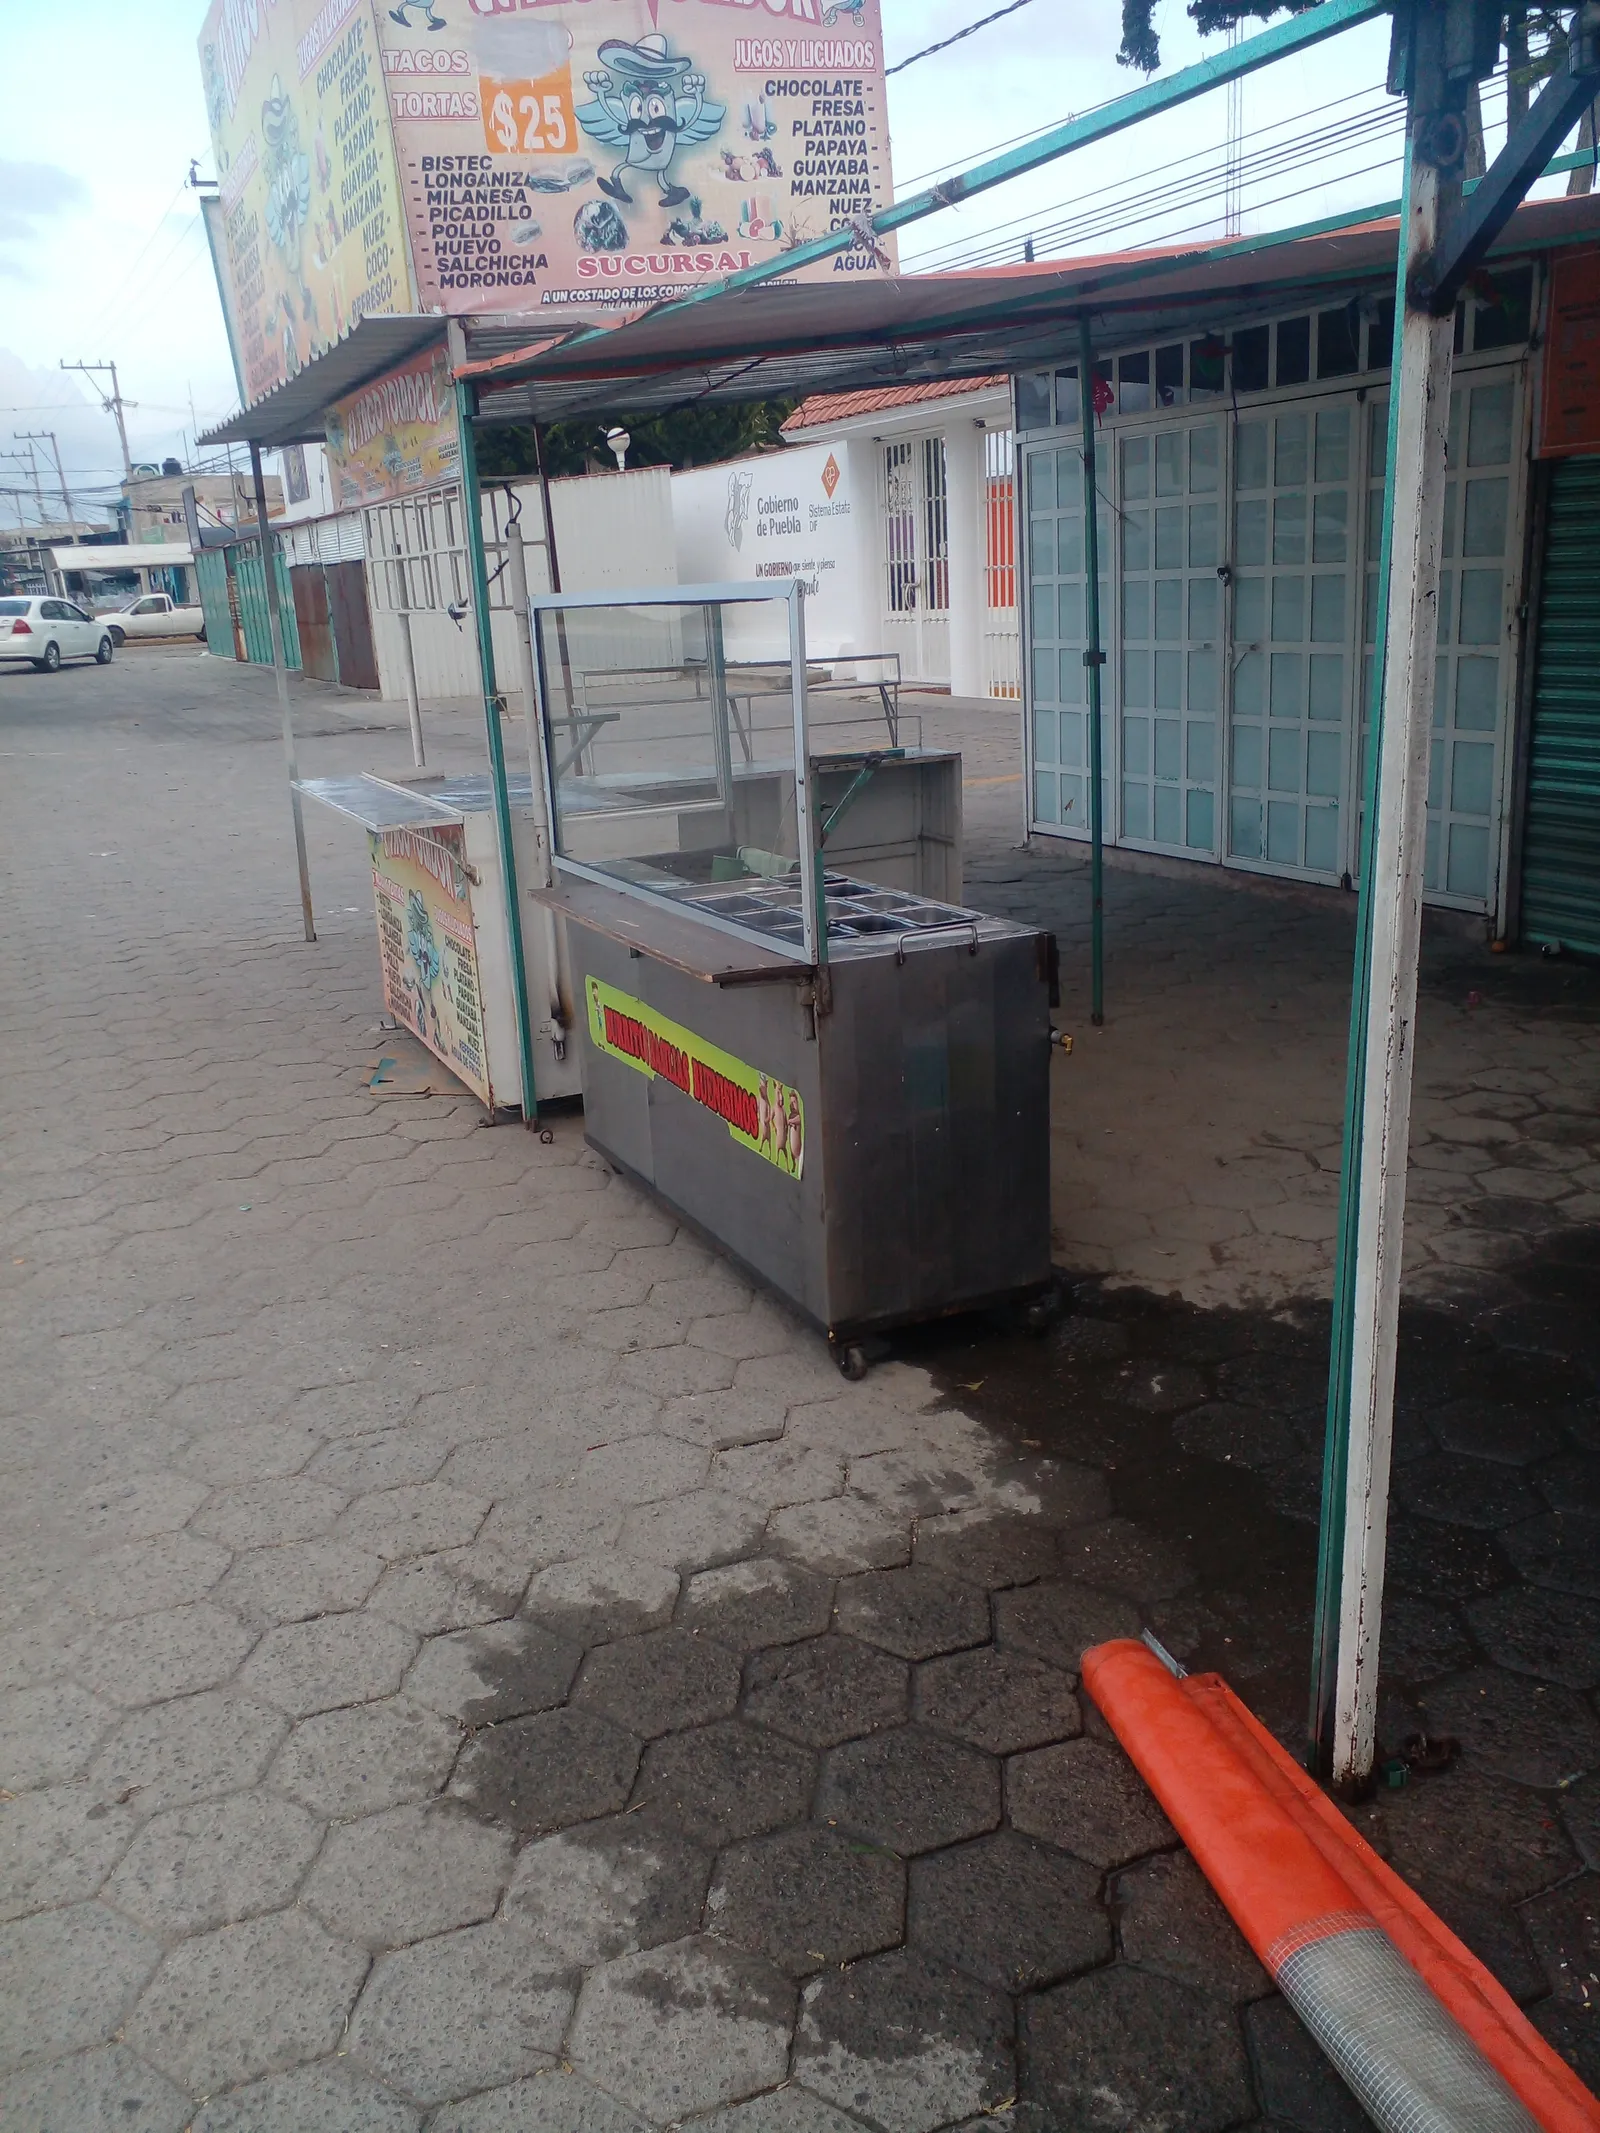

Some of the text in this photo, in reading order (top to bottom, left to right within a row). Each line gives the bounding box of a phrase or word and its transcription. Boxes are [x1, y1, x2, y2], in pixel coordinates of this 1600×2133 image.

[316, 16, 362, 99] CHOCOLATE
[384, 50, 469, 74] TACOS
[735, 39, 876, 69] JUGOS Y LICUADOS
[340, 51, 368, 104] FRESA
[765, 80, 863, 97] CHOCOLATE
[392, 92, 479, 117] TORTAS
[812, 100, 865, 117] FRESA
[334, 84, 371, 147] PLATANO
[494, 90, 567, 153] $25
[792, 120, 866, 137] PLATANO
[343, 115, 375, 170] PAPAYA
[804, 140, 868, 157] PAPAYA
[421, 155, 492, 172] BISTEC
[793, 160, 869, 177] GUAYABA
[340, 148, 379, 204] GUAYABA
[427, 188, 527, 206] MILANESA
[790, 179, 871, 197] MANZANA
[342, 179, 382, 237] MANZANA
[429, 205, 533, 222] PICADILLO
[829, 198, 872, 215] NUEZ
[362, 210, 386, 252] NUEZ
[432, 222, 495, 239] POLLO
[434, 239, 502, 256] HUEVO
[365, 242, 389, 282] COCO
[437, 254, 549, 273] SALCHICHA
[833, 255, 877, 272] AGUA
[439, 270, 537, 289] MORONGA
[541, 291, 551, 305] A
[551, 290, 568, 304] UN
[569, 288, 620, 303] COSTADO
[621, 287, 636, 300] DE
[637, 286, 657, 299] LOS
[757, 495, 799, 515] Gobierno
[808, 503, 832, 518] Sistema
[757, 516, 801, 537] de Puebla
[756, 562, 764, 578] UN
[764, 561, 793, 578] GOBIERNO
[802, 558, 816, 572] siente
